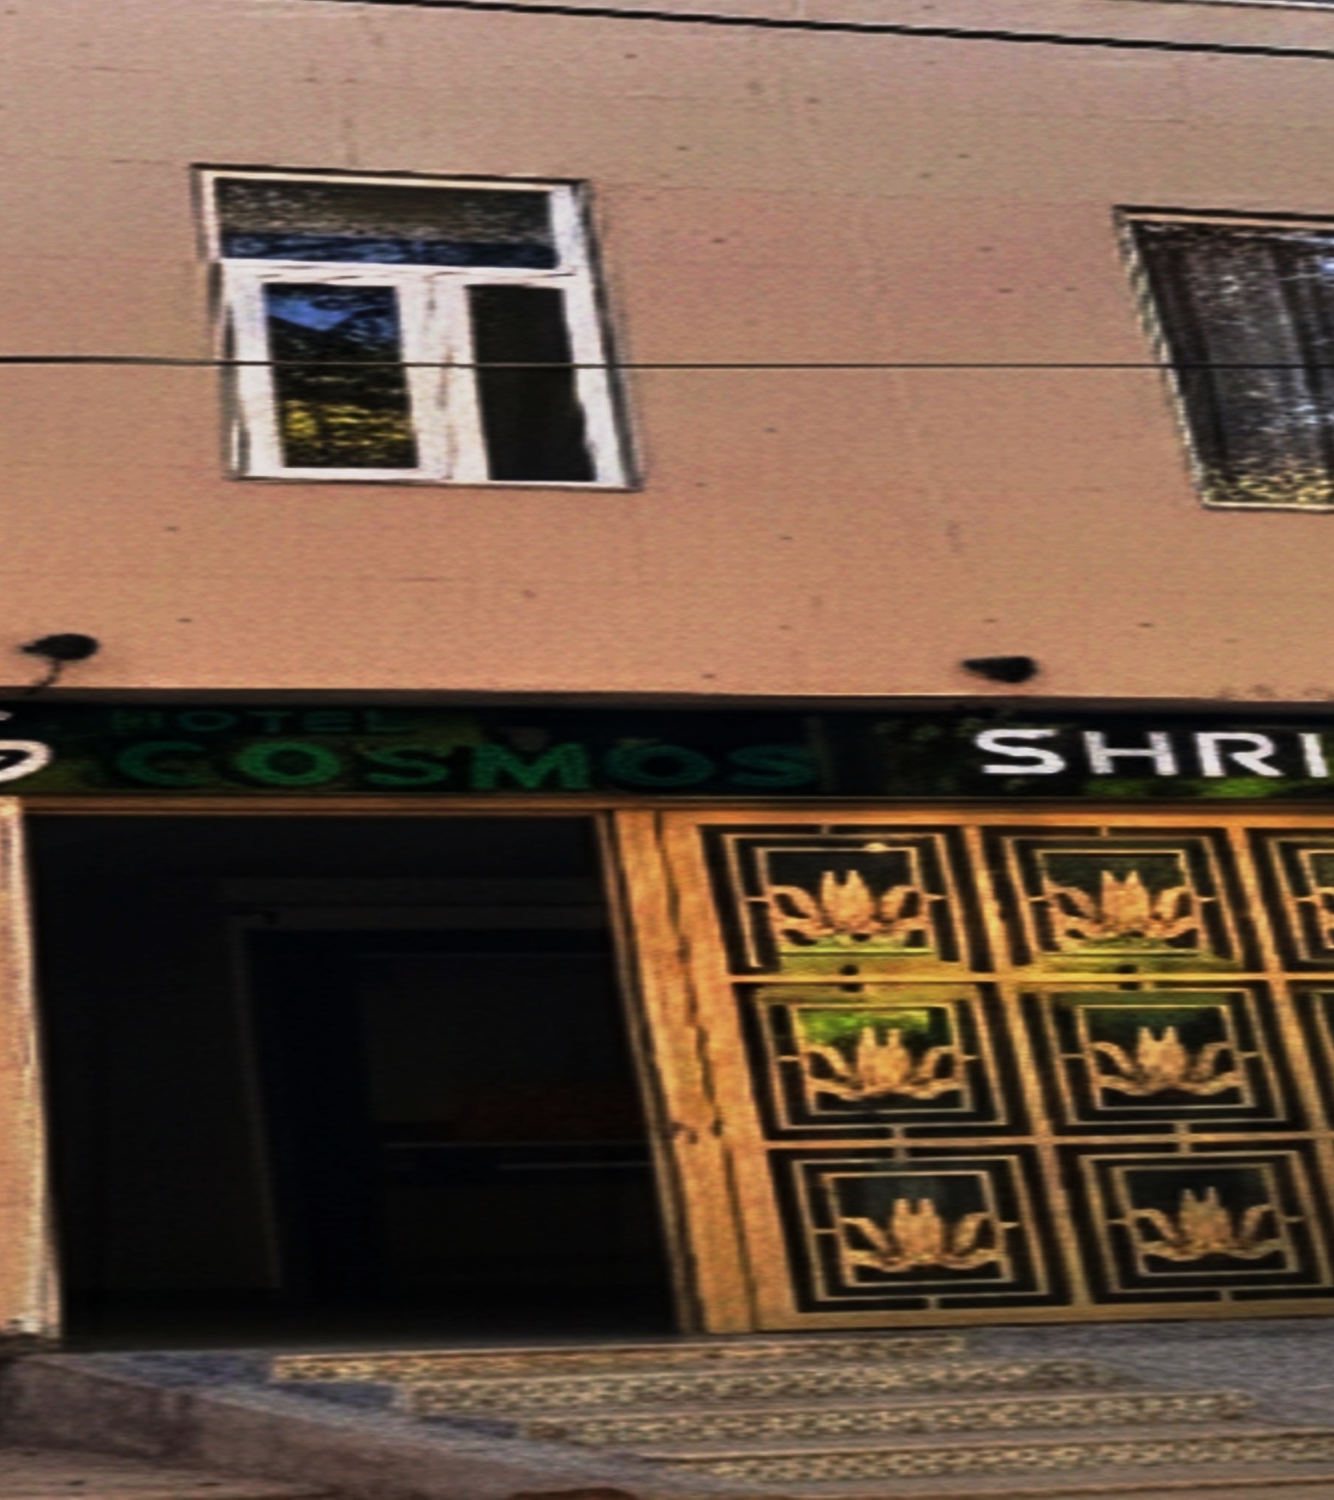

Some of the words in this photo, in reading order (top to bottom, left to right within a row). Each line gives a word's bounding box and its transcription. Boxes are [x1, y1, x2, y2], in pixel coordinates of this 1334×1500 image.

[109, 709, 418, 734] HOTEL
[113, 739, 818, 790] COSMOS
[975, 729, 1328, 778] SHRI
